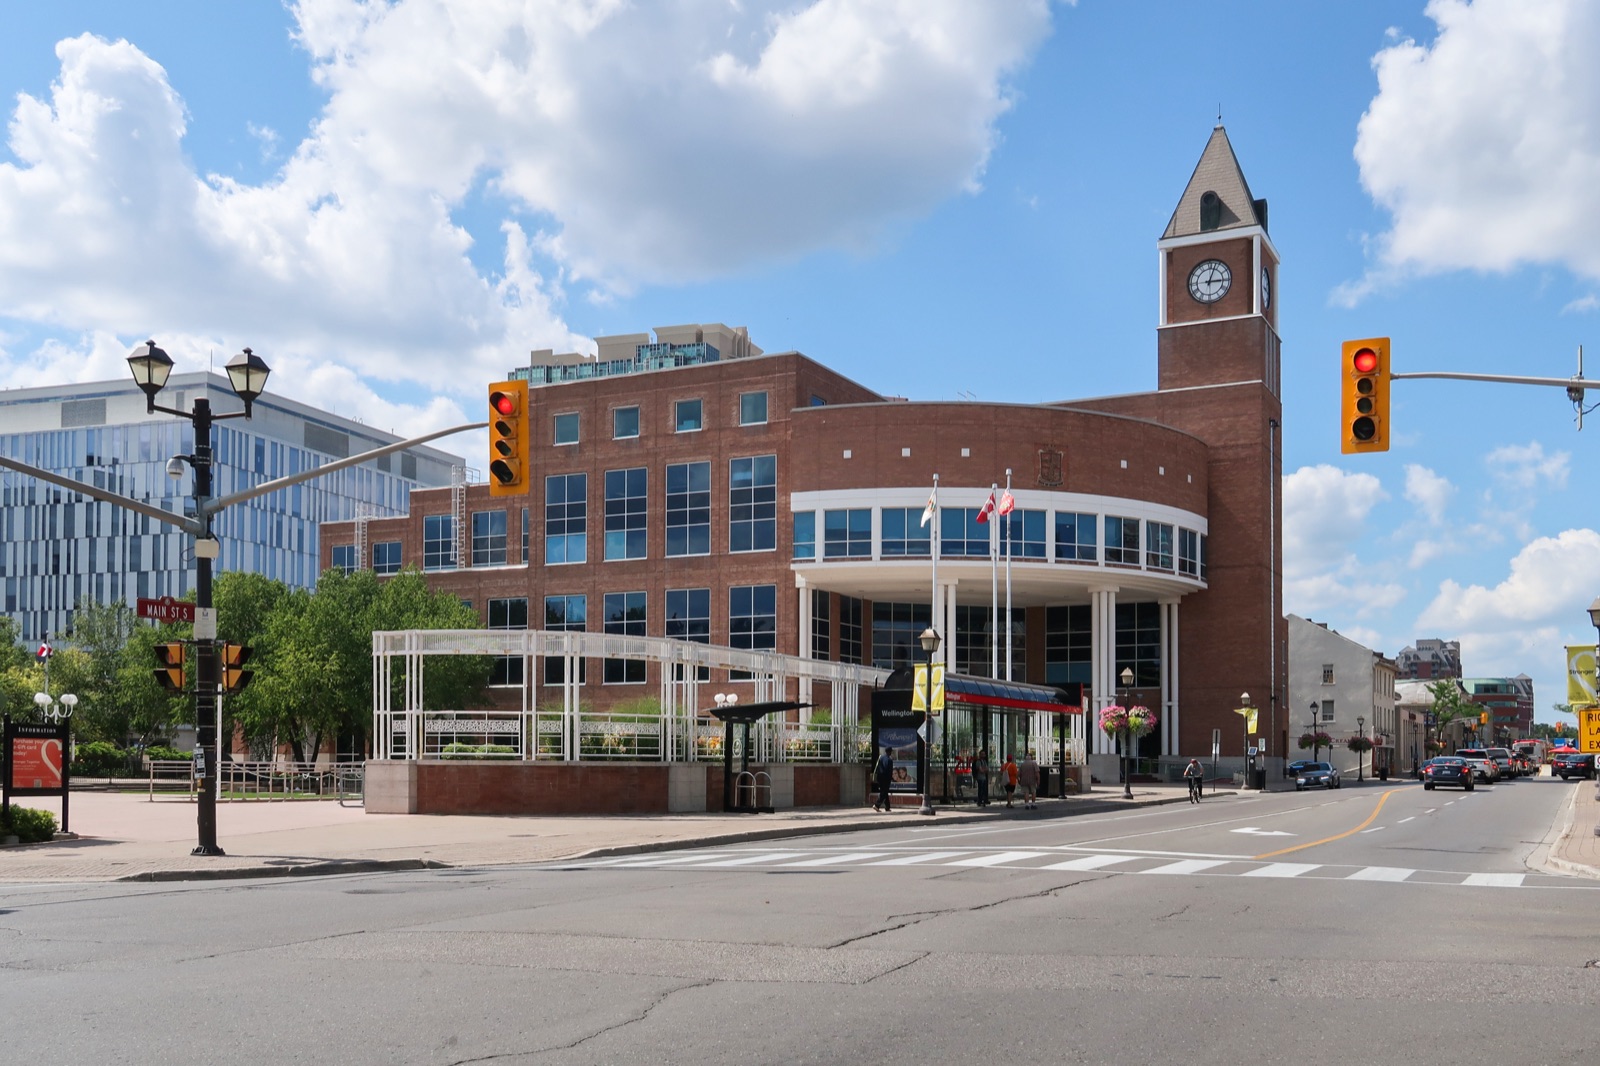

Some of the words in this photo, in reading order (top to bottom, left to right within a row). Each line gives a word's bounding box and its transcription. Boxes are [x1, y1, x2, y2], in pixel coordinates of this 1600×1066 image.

[147, 604, 167, 617] MAIN
[171, 606, 179, 618] ST
[183, 608, 188, 619] S
[881, 709, 914, 718] Wellington
